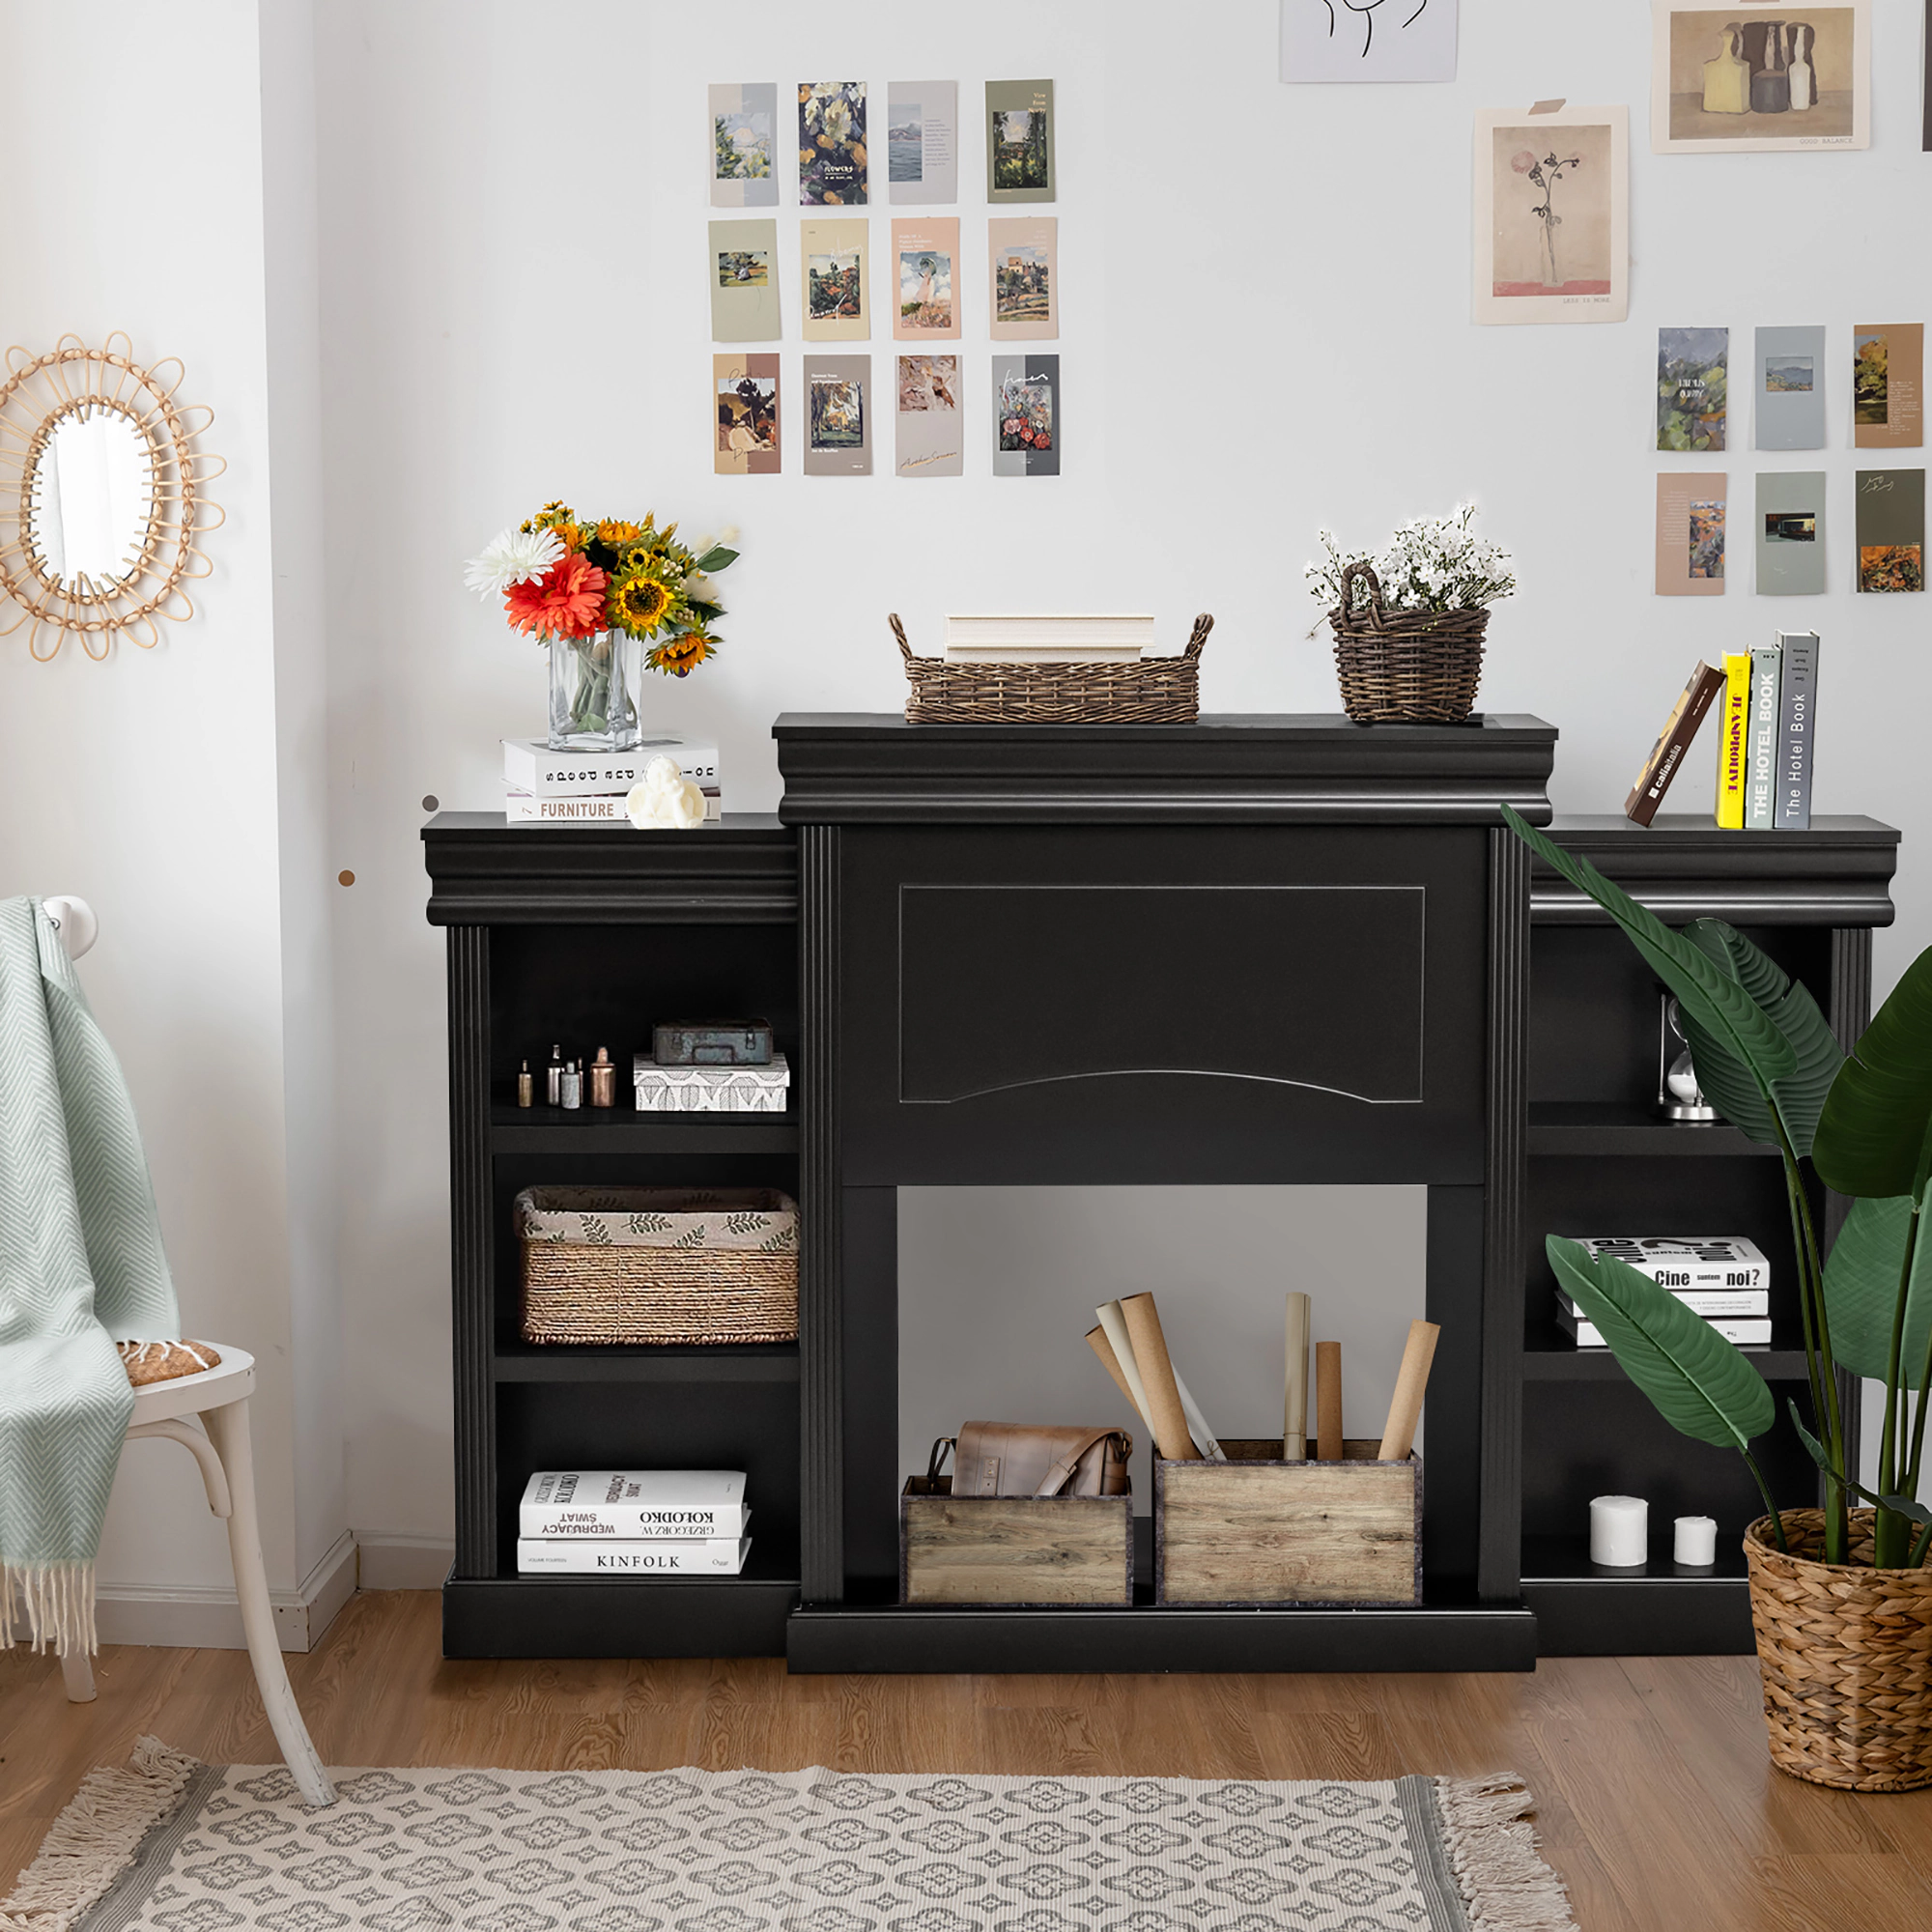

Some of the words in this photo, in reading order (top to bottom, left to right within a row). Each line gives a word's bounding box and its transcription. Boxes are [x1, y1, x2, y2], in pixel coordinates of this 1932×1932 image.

[1758, 672, 1775, 723] BOOK
[1790, 694, 1805, 732] Book
[1755, 725, 1772, 781] HOTEL
[1788, 740, 1804, 781] Hotel
[604, 769, 635, 780] and
[1753, 784, 1769, 819] THE
[1786, 789, 1802, 818] The
[541, 803, 614, 818] FURNITURE
[1655, 1270, 1690, 1287] Cine
[1726, 1268, 1760, 1287] noi?
[560, 1512, 597, 1524] ŚWIAT
[639, 1512, 714, 1523] KOŁODKO
[542, 1522, 615, 1534] WĘDRUJĄCY
[655, 1525, 715, 1535] GRZEGORZ
[597, 1555, 680, 1568] KINFOLK
